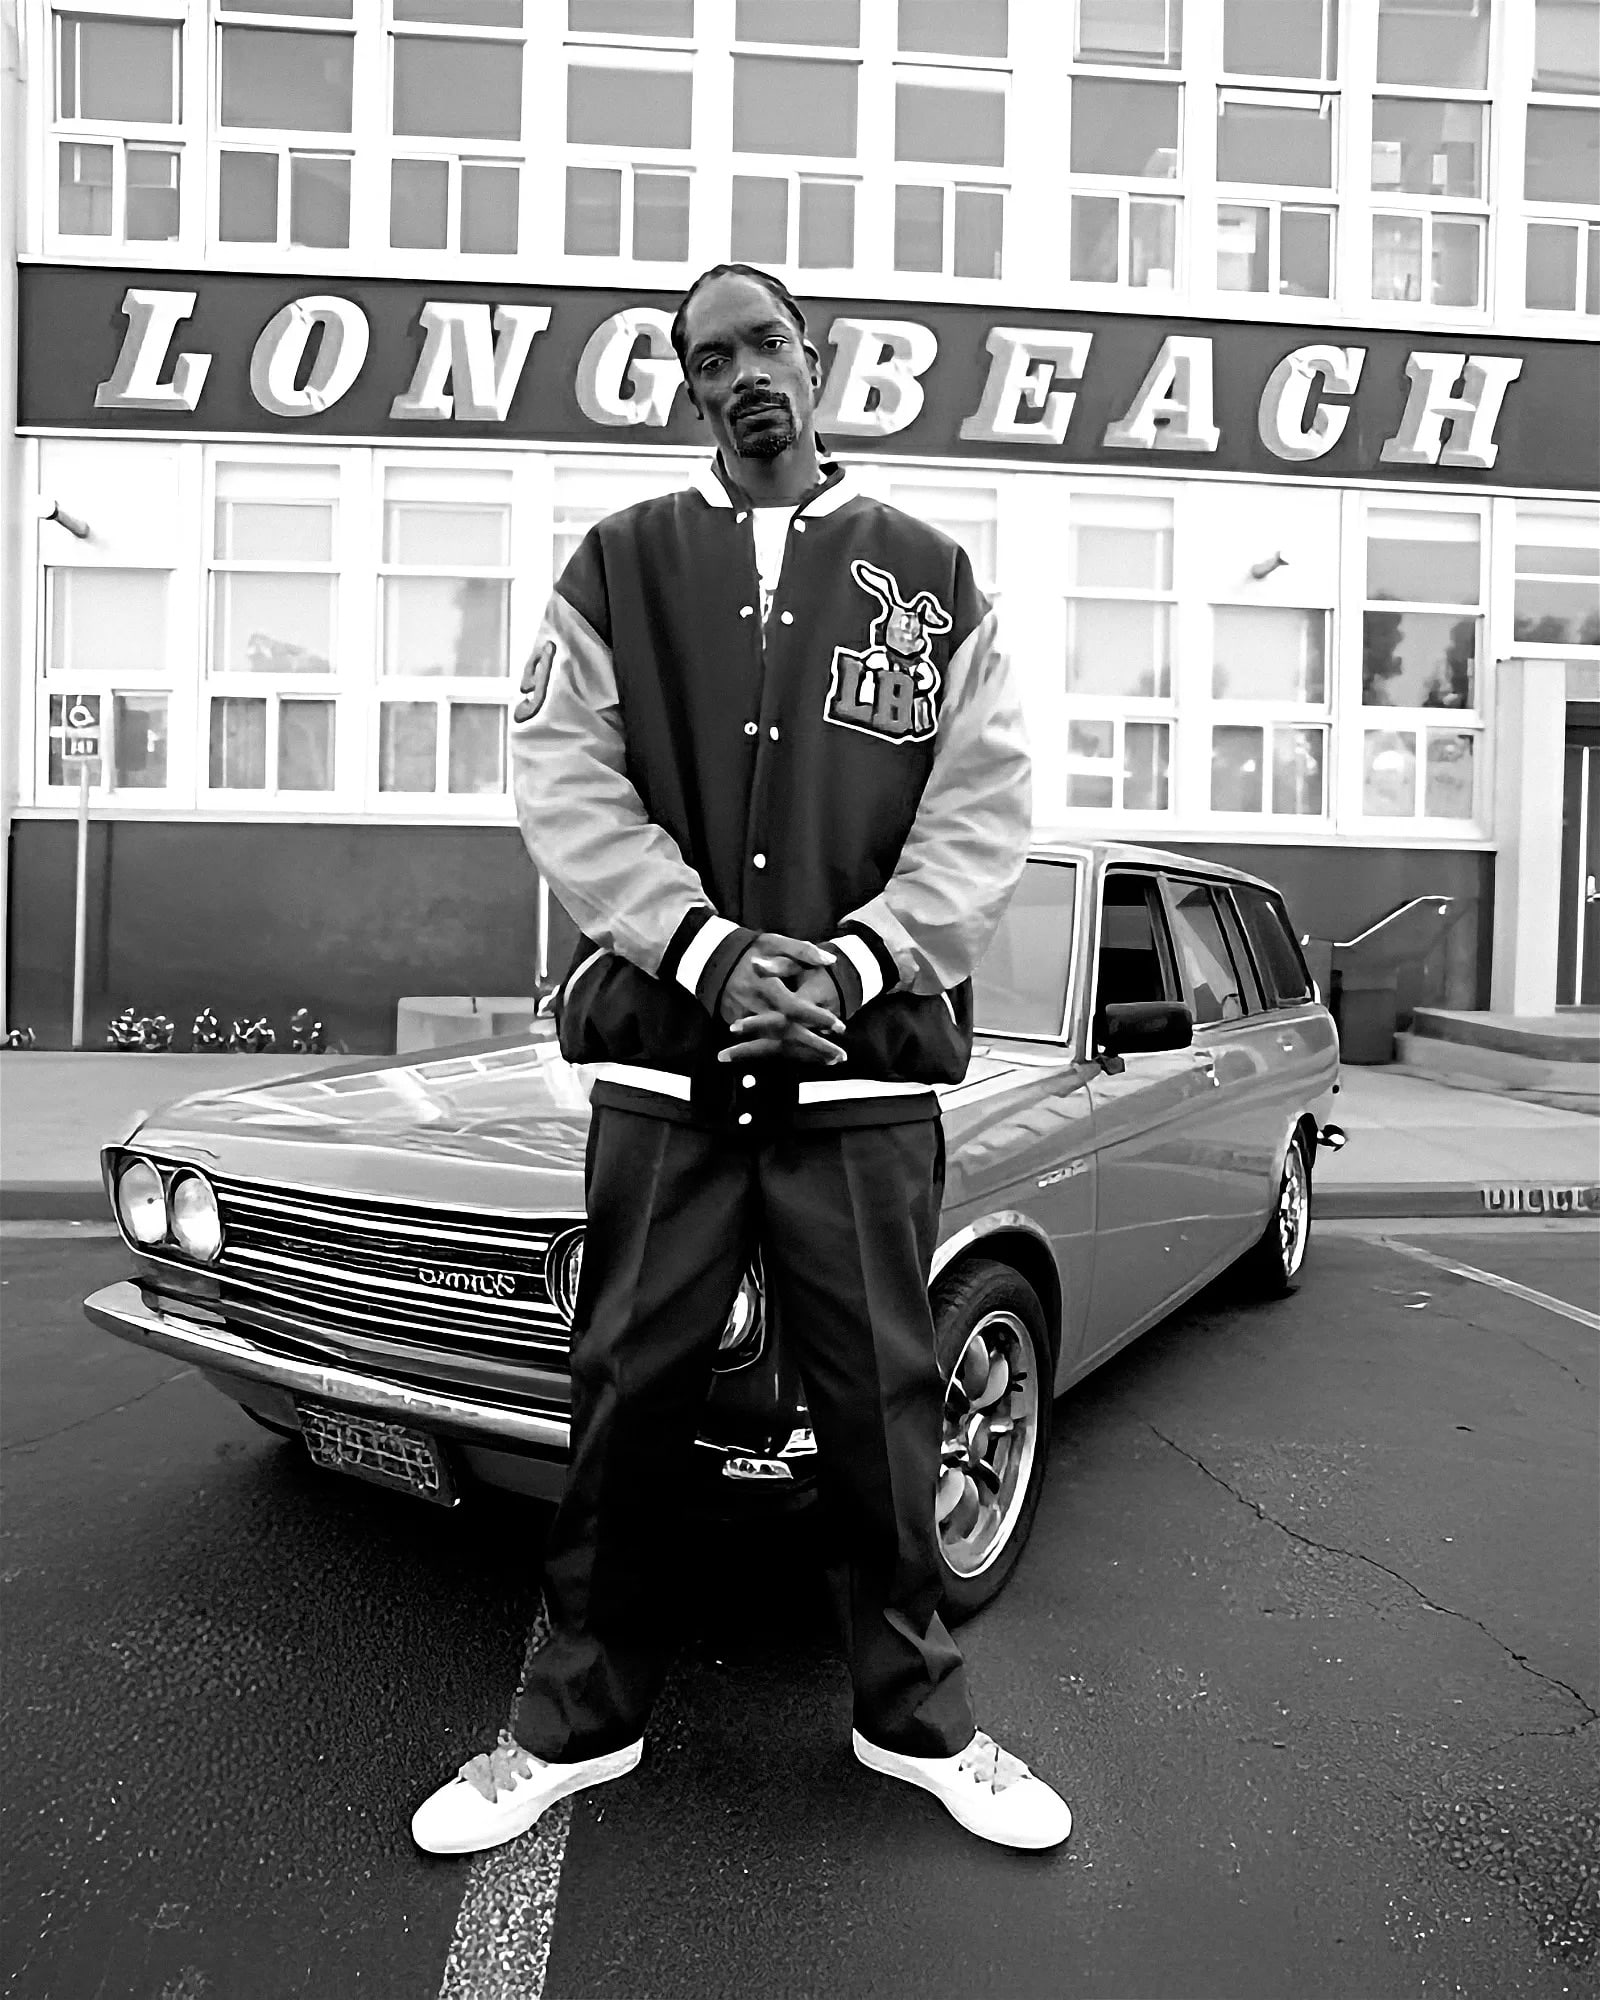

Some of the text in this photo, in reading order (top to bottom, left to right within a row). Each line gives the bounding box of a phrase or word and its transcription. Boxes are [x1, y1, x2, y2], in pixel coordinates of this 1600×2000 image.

[94, 288, 1524, 469] LONG BEACH
[833, 655, 915, 735] LB
